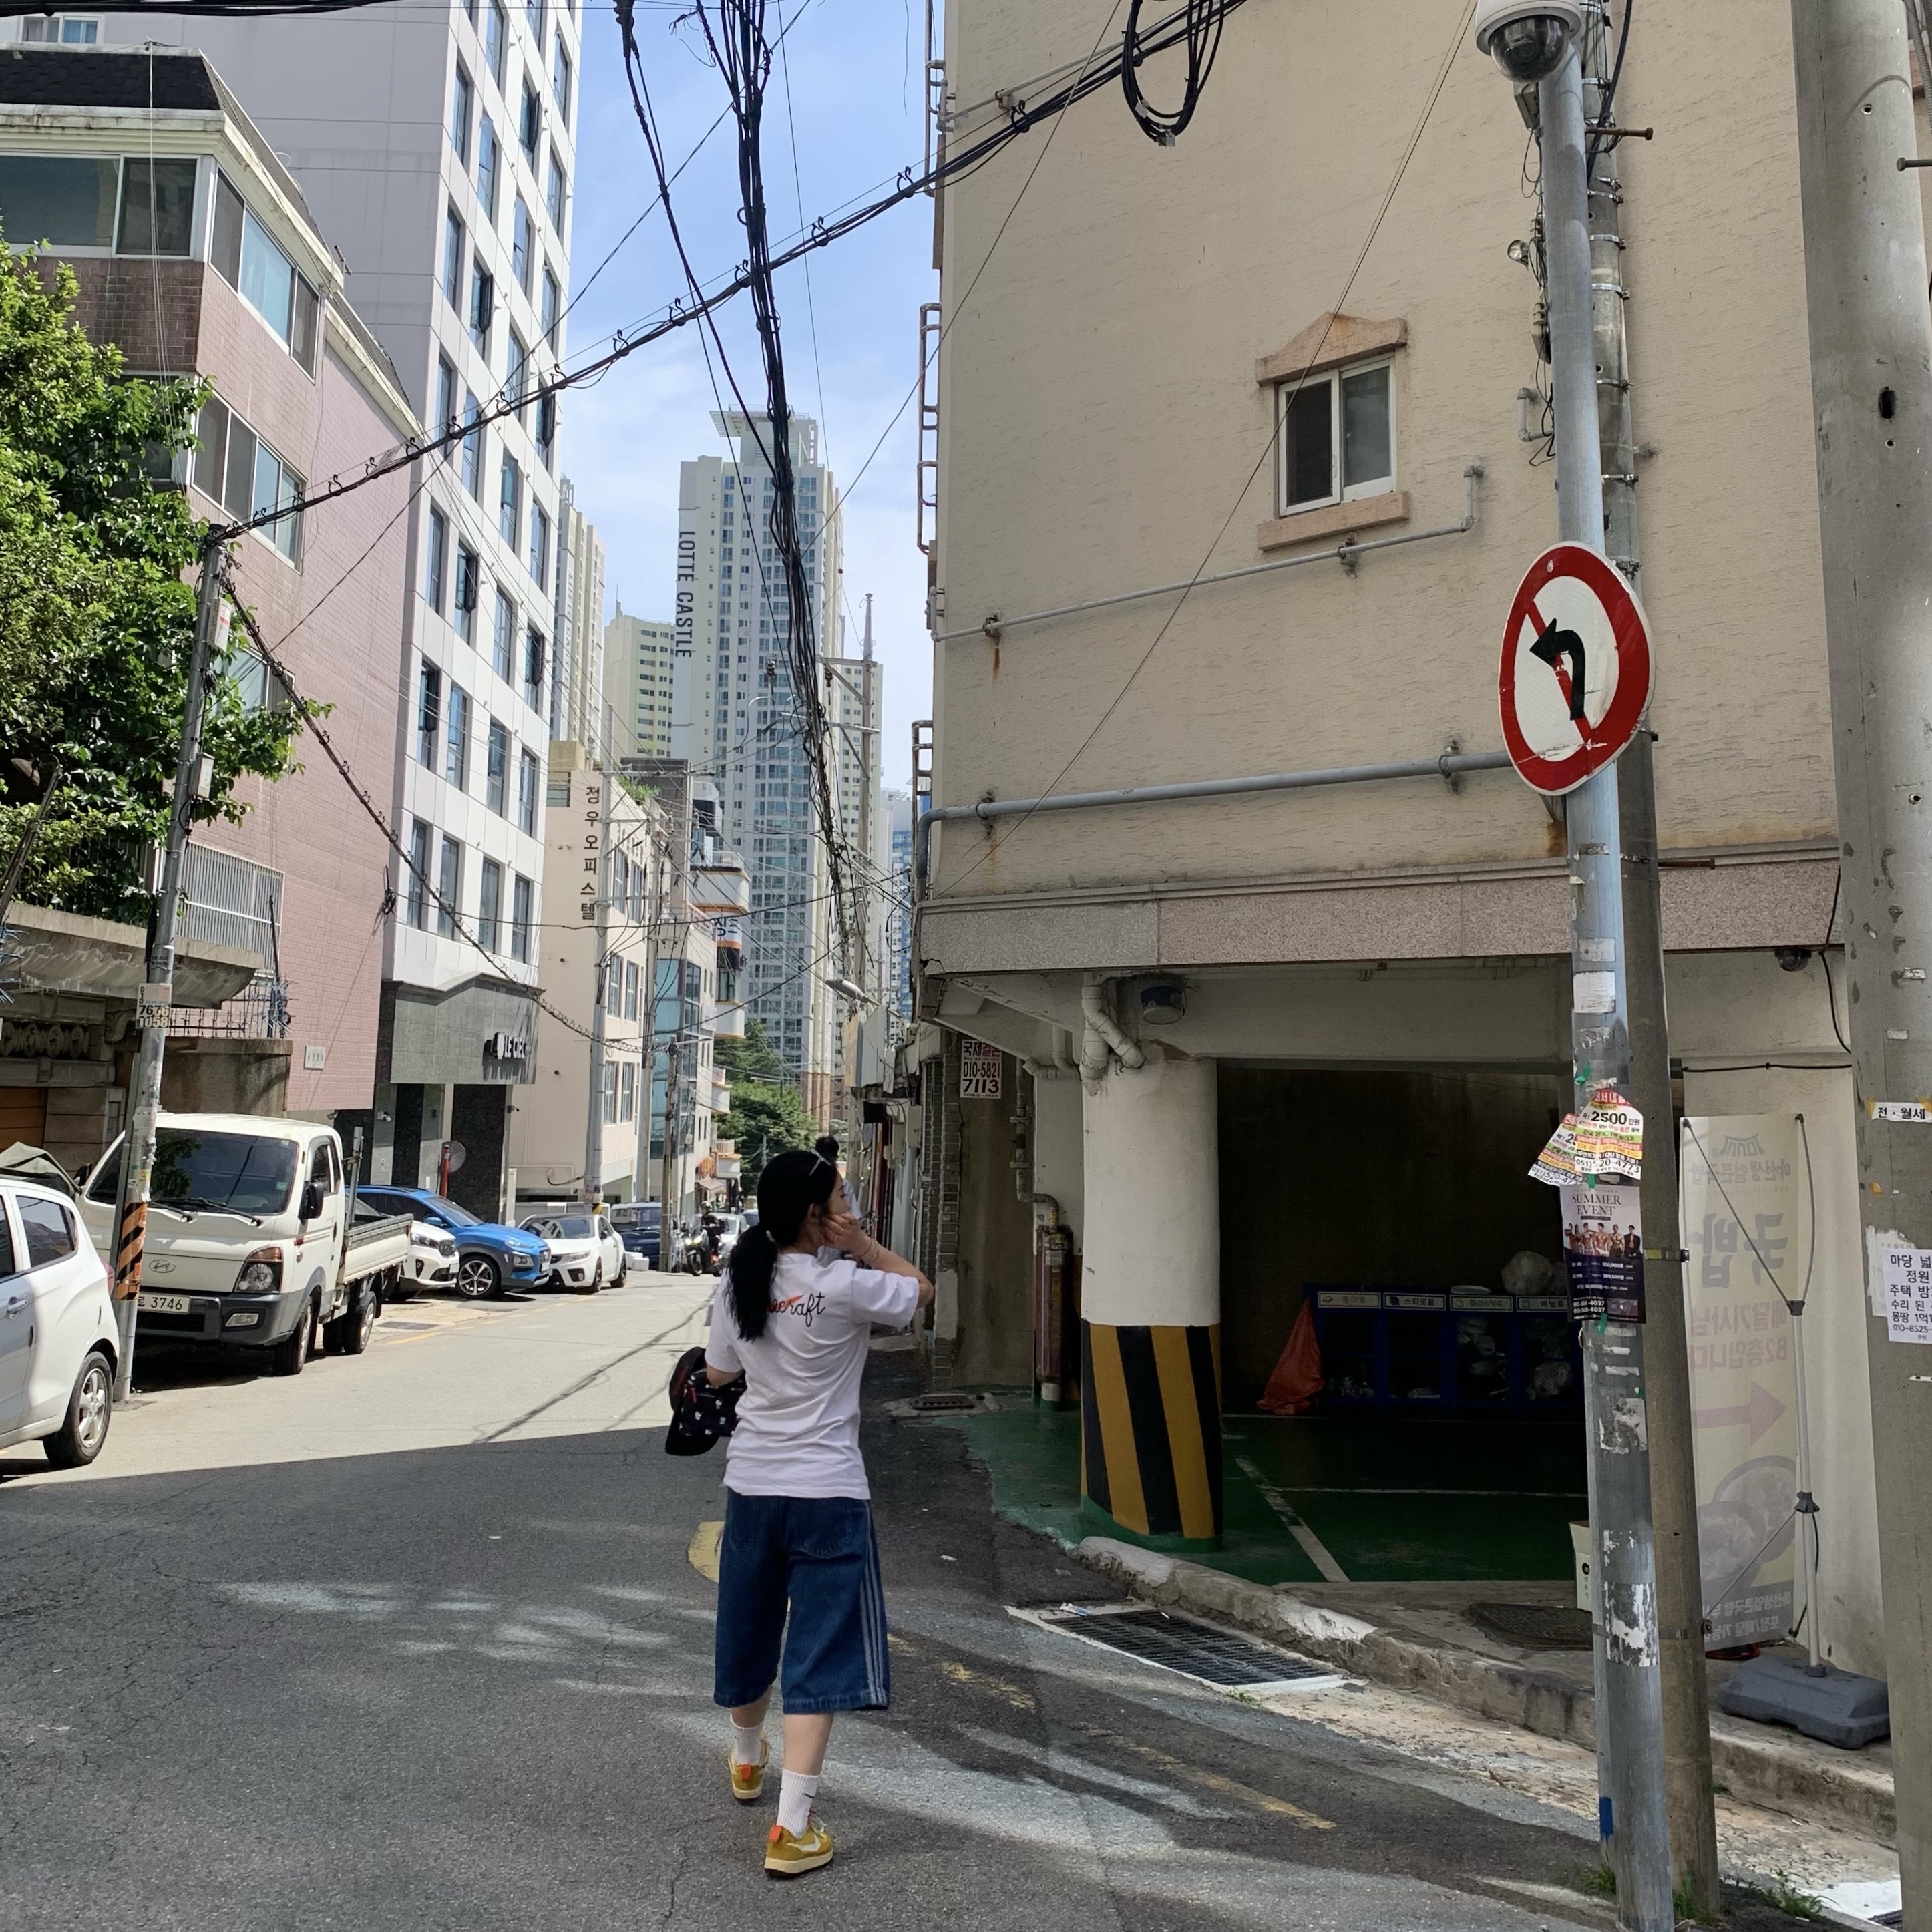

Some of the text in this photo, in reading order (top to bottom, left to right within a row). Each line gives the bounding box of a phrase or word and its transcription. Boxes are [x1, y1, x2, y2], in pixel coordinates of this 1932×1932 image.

[675, 531, 695, 658] LOTTE CASTLE
[580, 787, 600, 920] 정우오피스텔
[962, 1078, 999, 1093] 7113
[1591, 1111, 1628, 1125] 2500
[1572, 1194, 1621, 1205] SUMMER
[1577, 1205, 1615, 1215] EVENT
[1891, 1255, 1932, 1269] 마당 넓
[1906, 1270, 1930, 1283] 정원
[1890, 1284, 1932, 1298] 주택 방
[151, 1297, 182, 1310] 3746
[1891, 1300, 1925, 1312] 수리 된
[1892, 1312, 1909, 1323] 몽땅
